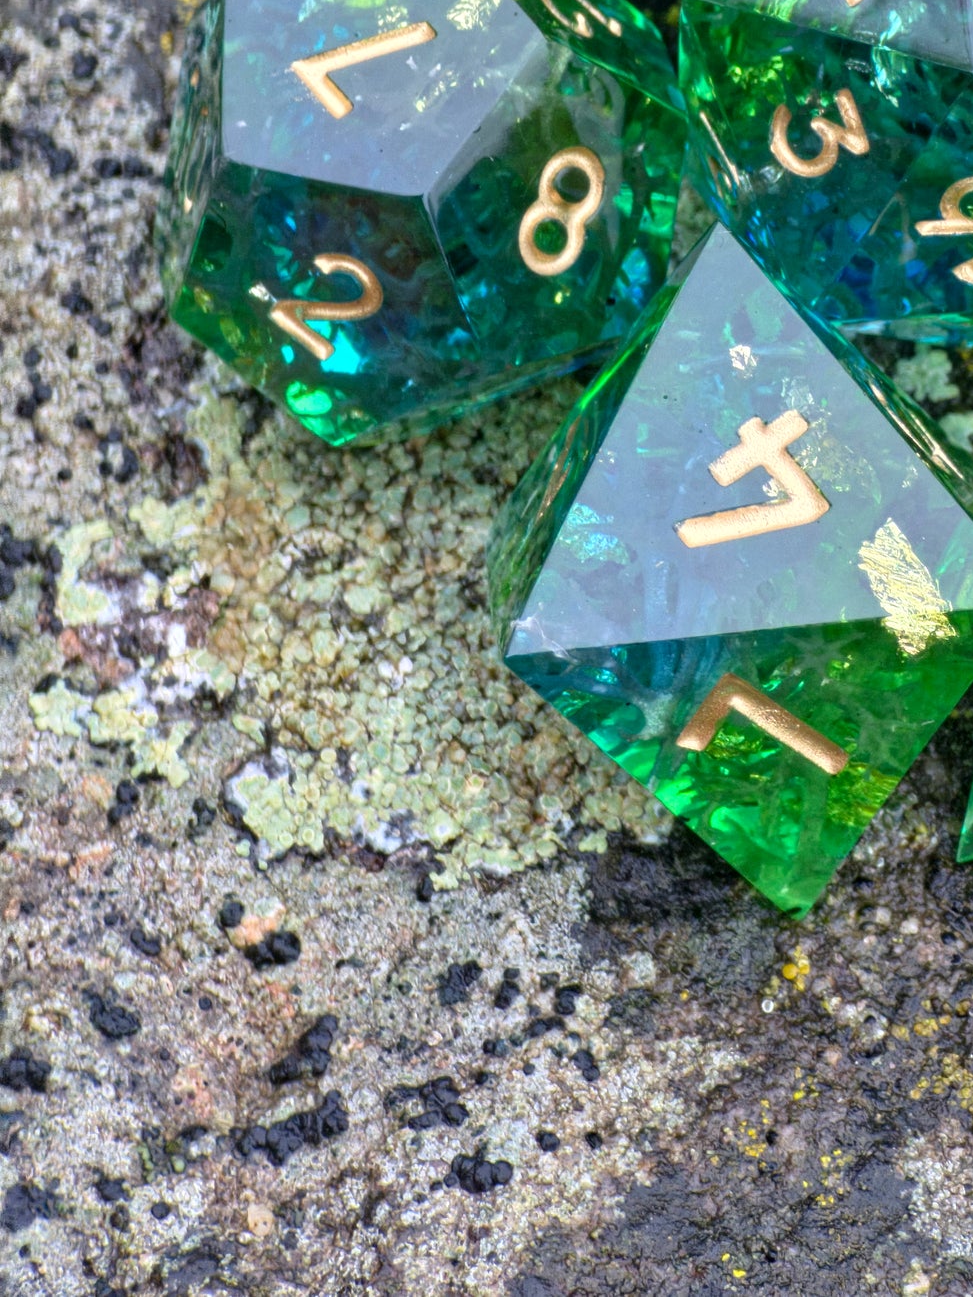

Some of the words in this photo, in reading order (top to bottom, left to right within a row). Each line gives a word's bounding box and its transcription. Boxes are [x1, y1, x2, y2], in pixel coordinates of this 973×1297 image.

[289, 20, 437, 119] 7
[770, 88, 871, 178] 3
[519, 147, 605, 276] 8
[269, 253, 384, 361] 2
[673, 409, 831, 548] 4
[675, 673, 851, 775] 7
